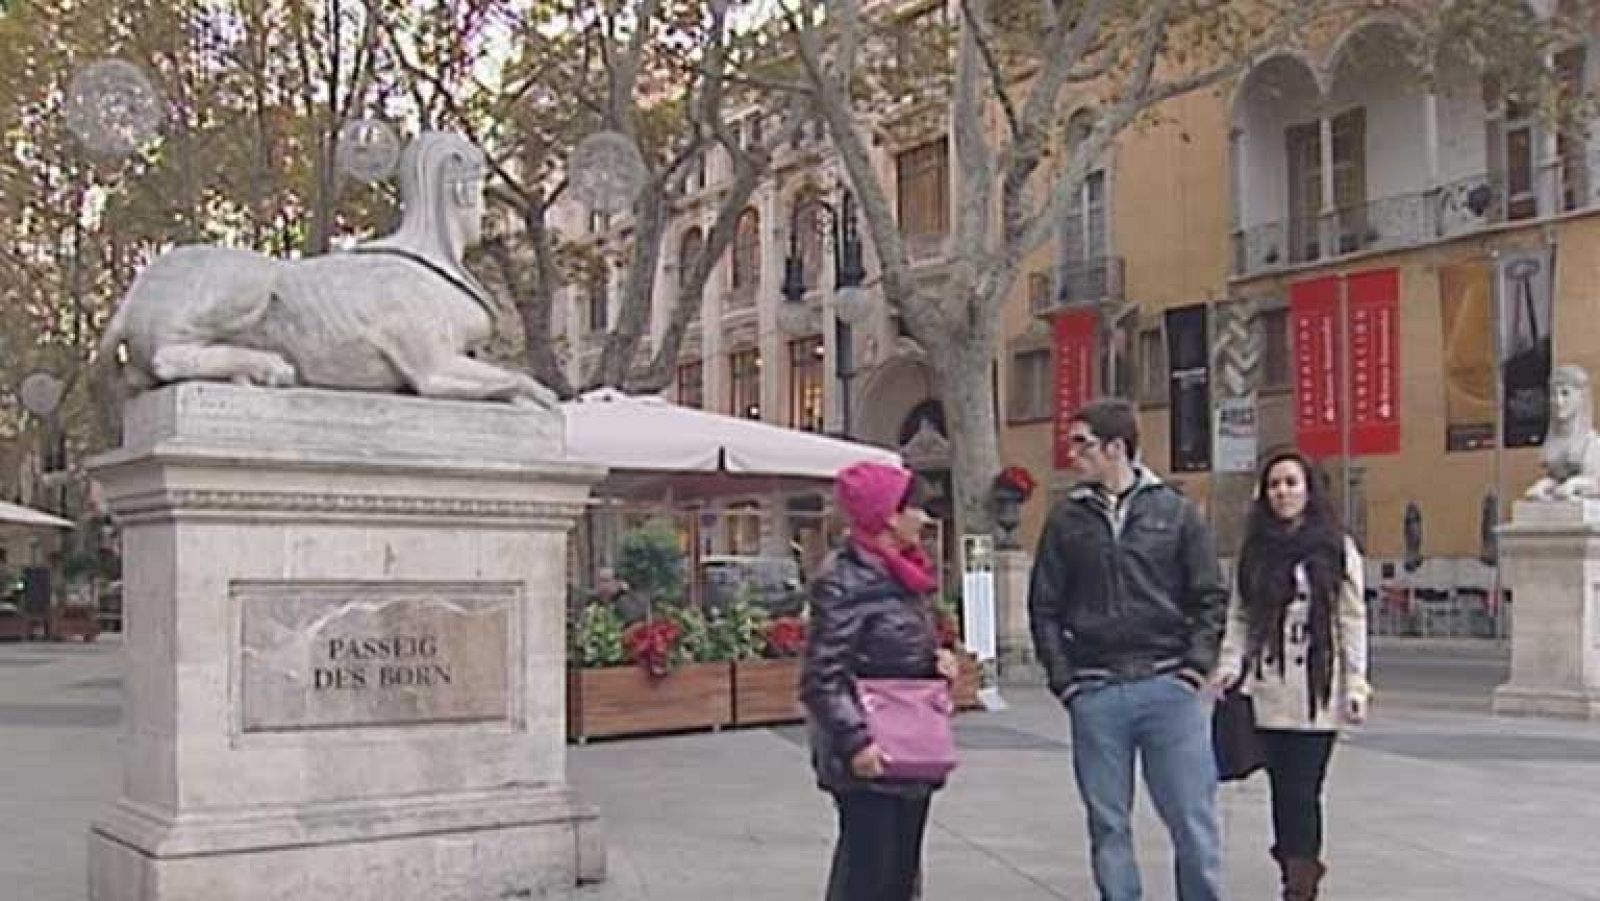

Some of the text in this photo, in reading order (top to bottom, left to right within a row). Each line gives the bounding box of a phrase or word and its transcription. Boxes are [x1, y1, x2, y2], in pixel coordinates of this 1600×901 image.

[328, 635, 438, 660] PASSEIG
[313, 664, 452, 690] DES BORN
